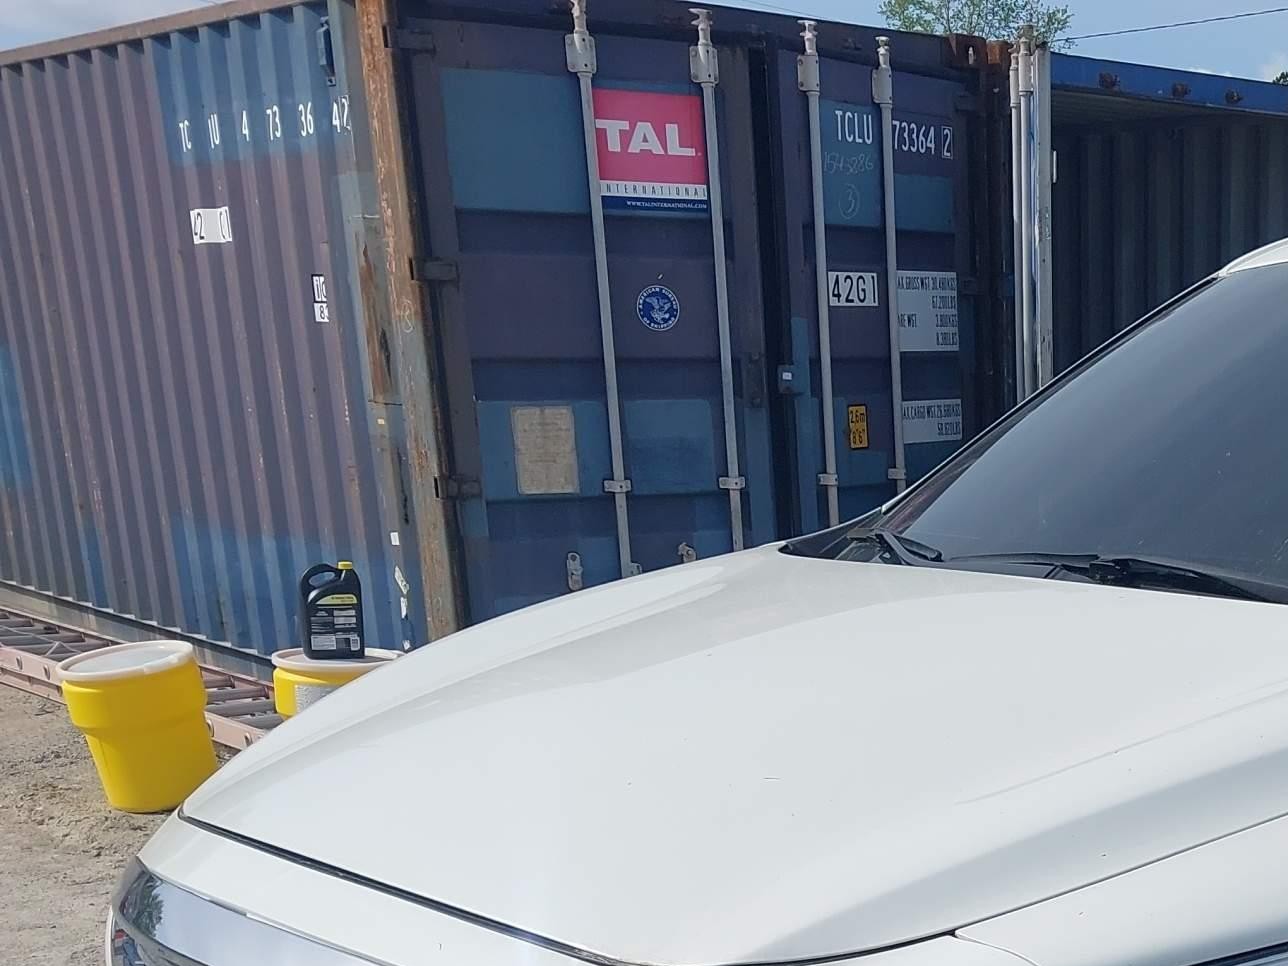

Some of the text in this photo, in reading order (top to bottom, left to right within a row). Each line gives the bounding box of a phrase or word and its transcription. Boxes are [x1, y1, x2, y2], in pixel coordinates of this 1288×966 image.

[241, 110, 250, 141] 4
[266, 105, 281, 140] 73
[299, 101, 314, 137] 36
[595, 119, 696, 156] TAL
[835, 110, 873, 144] TCLU
[943, 129, 951, 156] 2
[606, 183, 706, 198] NTERNATIONAL
[832, 274, 877, 304] 42G1
